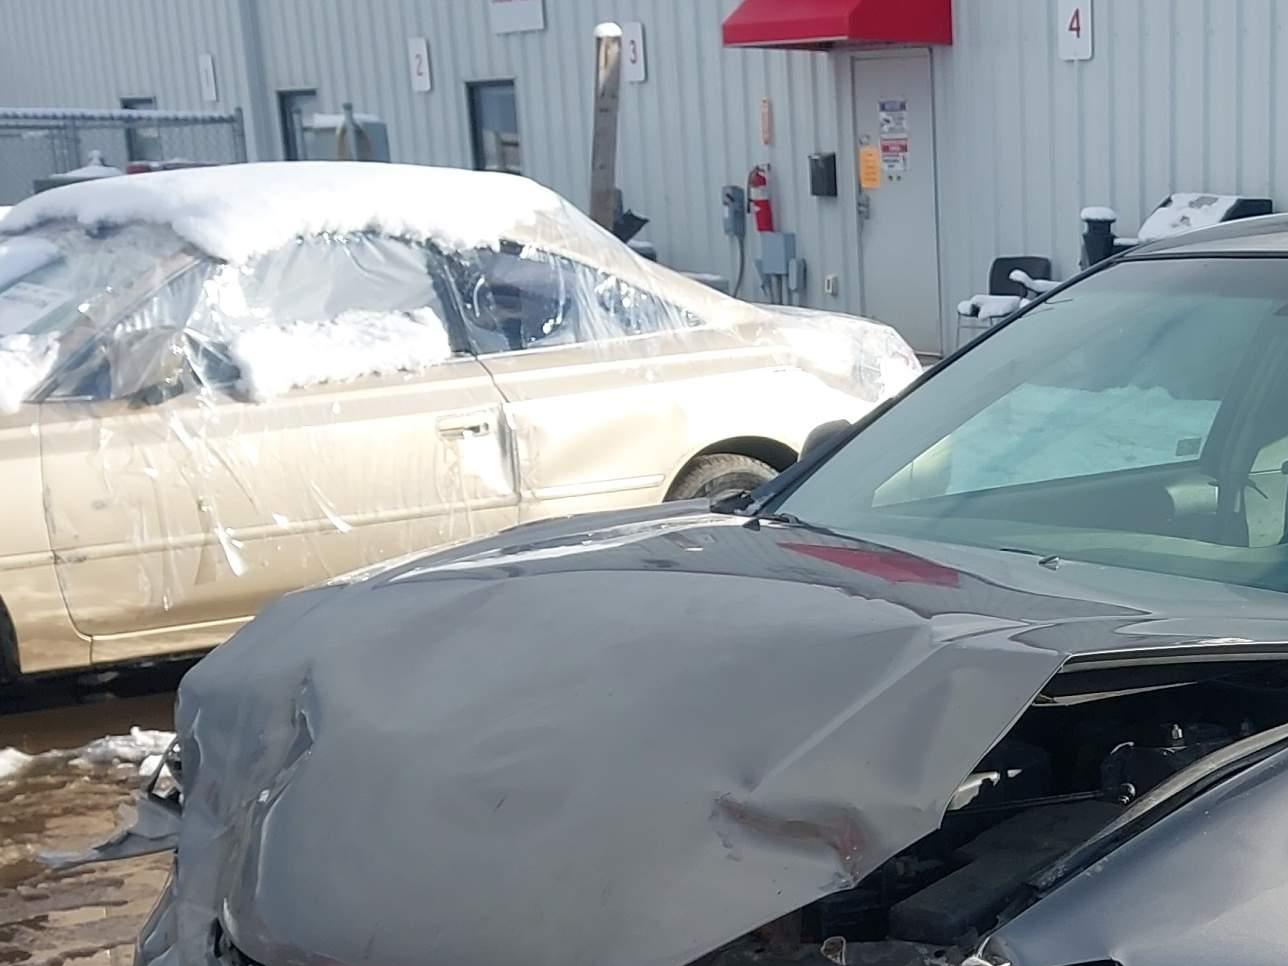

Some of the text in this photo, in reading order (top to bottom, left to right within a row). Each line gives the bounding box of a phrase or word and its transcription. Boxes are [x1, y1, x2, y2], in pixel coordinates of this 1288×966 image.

[1068, 7, 1081, 39] 4
[629, 39, 638, 64] 3
[415, 53, 424, 77] 2
